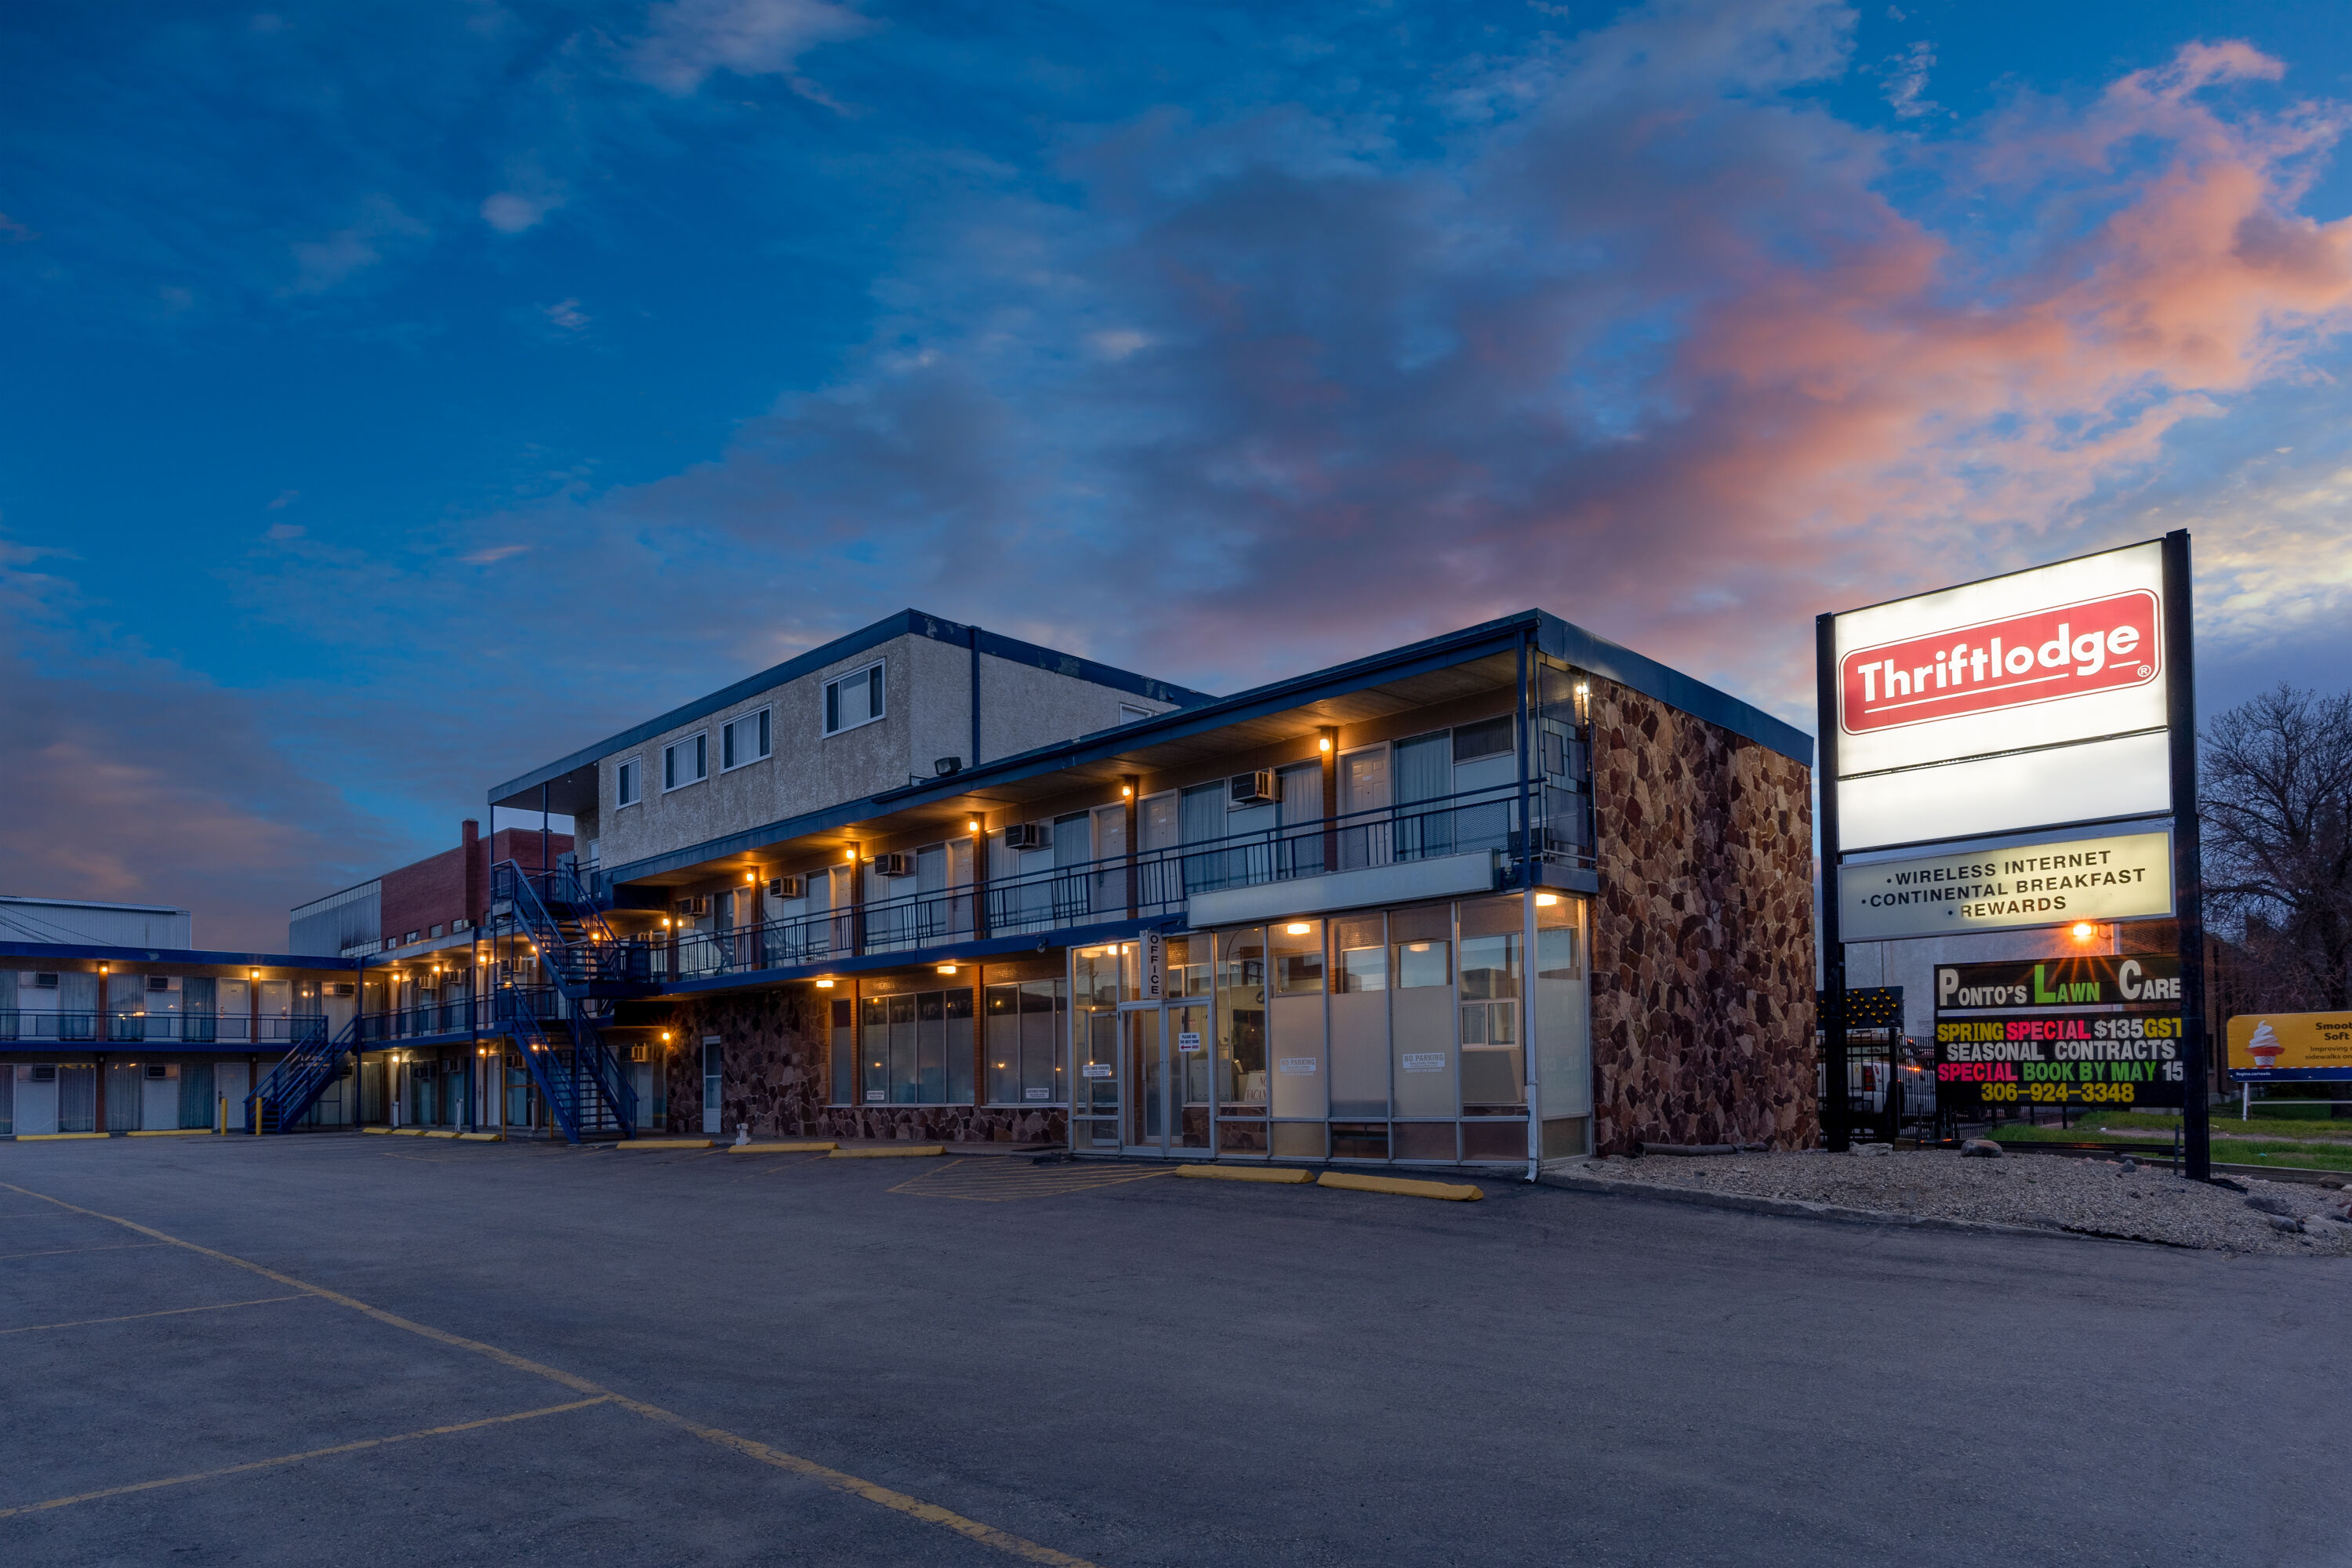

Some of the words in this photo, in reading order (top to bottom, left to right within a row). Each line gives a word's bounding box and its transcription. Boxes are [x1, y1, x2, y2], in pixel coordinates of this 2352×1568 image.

[1858, 622, 2140, 702] Thriftlodge
[1896, 863, 1996, 885] WIRELESS
[2005, 850, 2111, 875] INTERNET
[1870, 883, 2008, 907] CONTINENTAL
[2016, 868, 2146, 894] BREAKFAST
[1961, 895, 2067, 918] REWARDS
[1150, 935, 1160, 994] OFFICE
[1939, 968, 2027, 1006] PONTO'S
[2034, 964, 2100, 1004] LAWN
[2119, 960, 2181, 1000] CARE
[1937, 1022, 2004, 1042] SPRING
[2006, 1020, 2091, 1040] SPECIAL
[2324, 1032, 2350, 1040] Soft
[1947, 1042, 2045, 1062] SEASONAL
[2055, 1040, 2176, 1060] CONTRACTS
[1938, 1062, 2018, 1082] SPECIAL
[2023, 1062, 2074, 1081] BOOK
[2079, 1062, 2106, 1081] BY
[2111, 1061, 2156, 1081] MAY
[2162, 1061, 2183, 1081] 15
[1981, 1083, 2135, 1102] 306-924-3348
